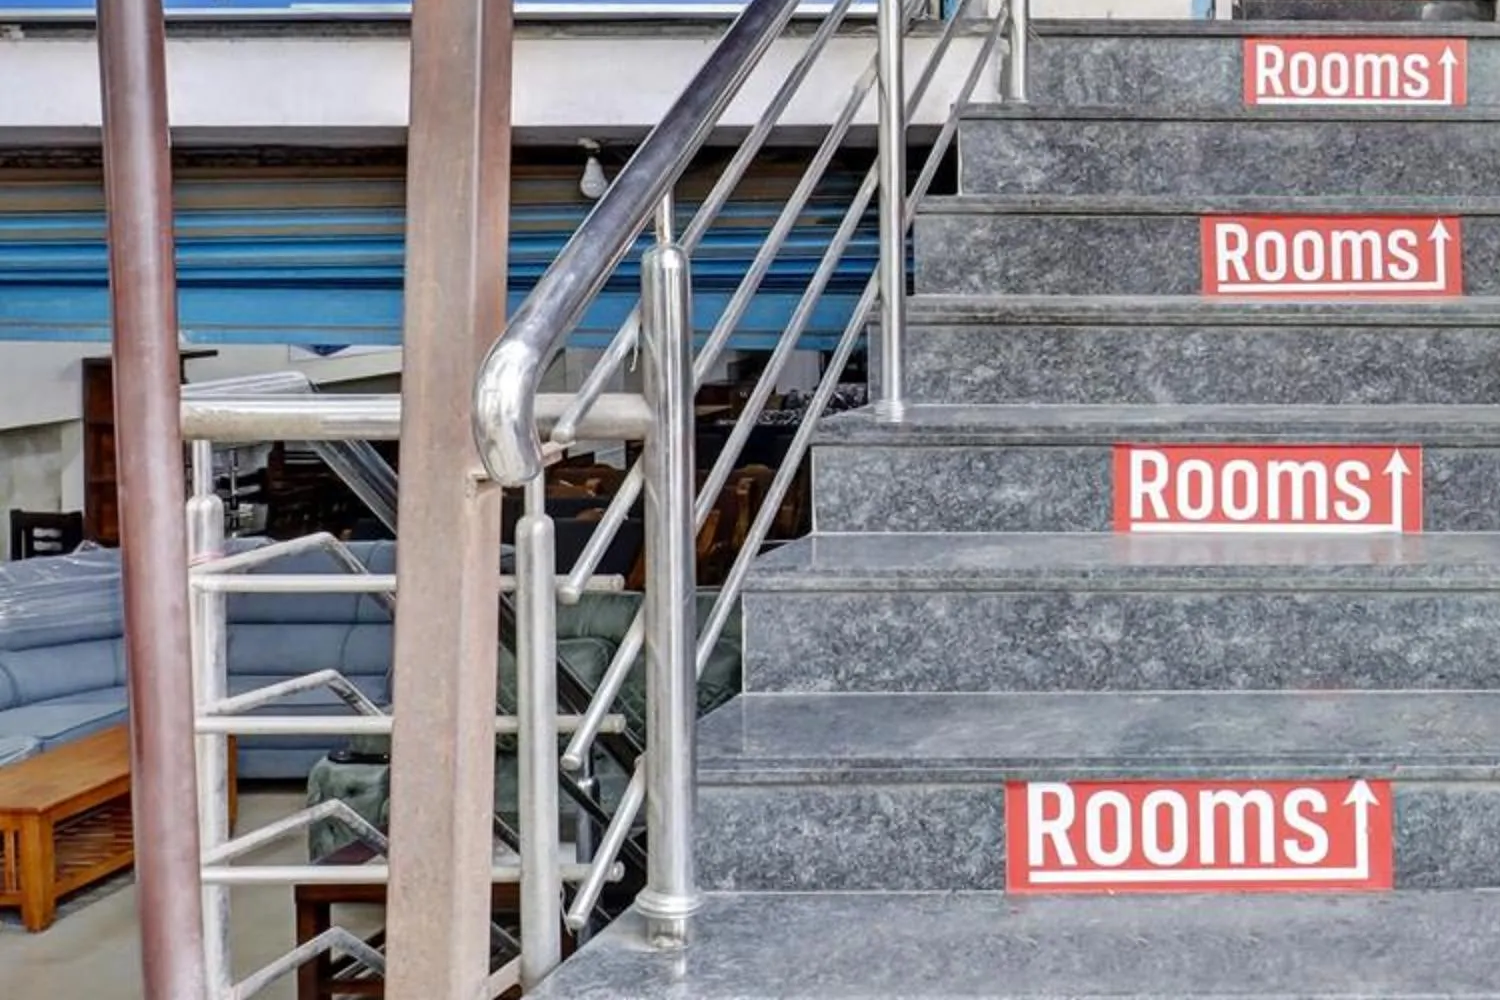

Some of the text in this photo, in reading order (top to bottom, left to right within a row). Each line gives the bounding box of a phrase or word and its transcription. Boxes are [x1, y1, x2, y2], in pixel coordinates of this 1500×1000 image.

[1256, 44, 1430, 98] Rooms
[1215, 223, 1420, 281] Rooms
[1129, 448, 1371, 521] Rooms
[1027, 781, 1330, 867] Rooms
